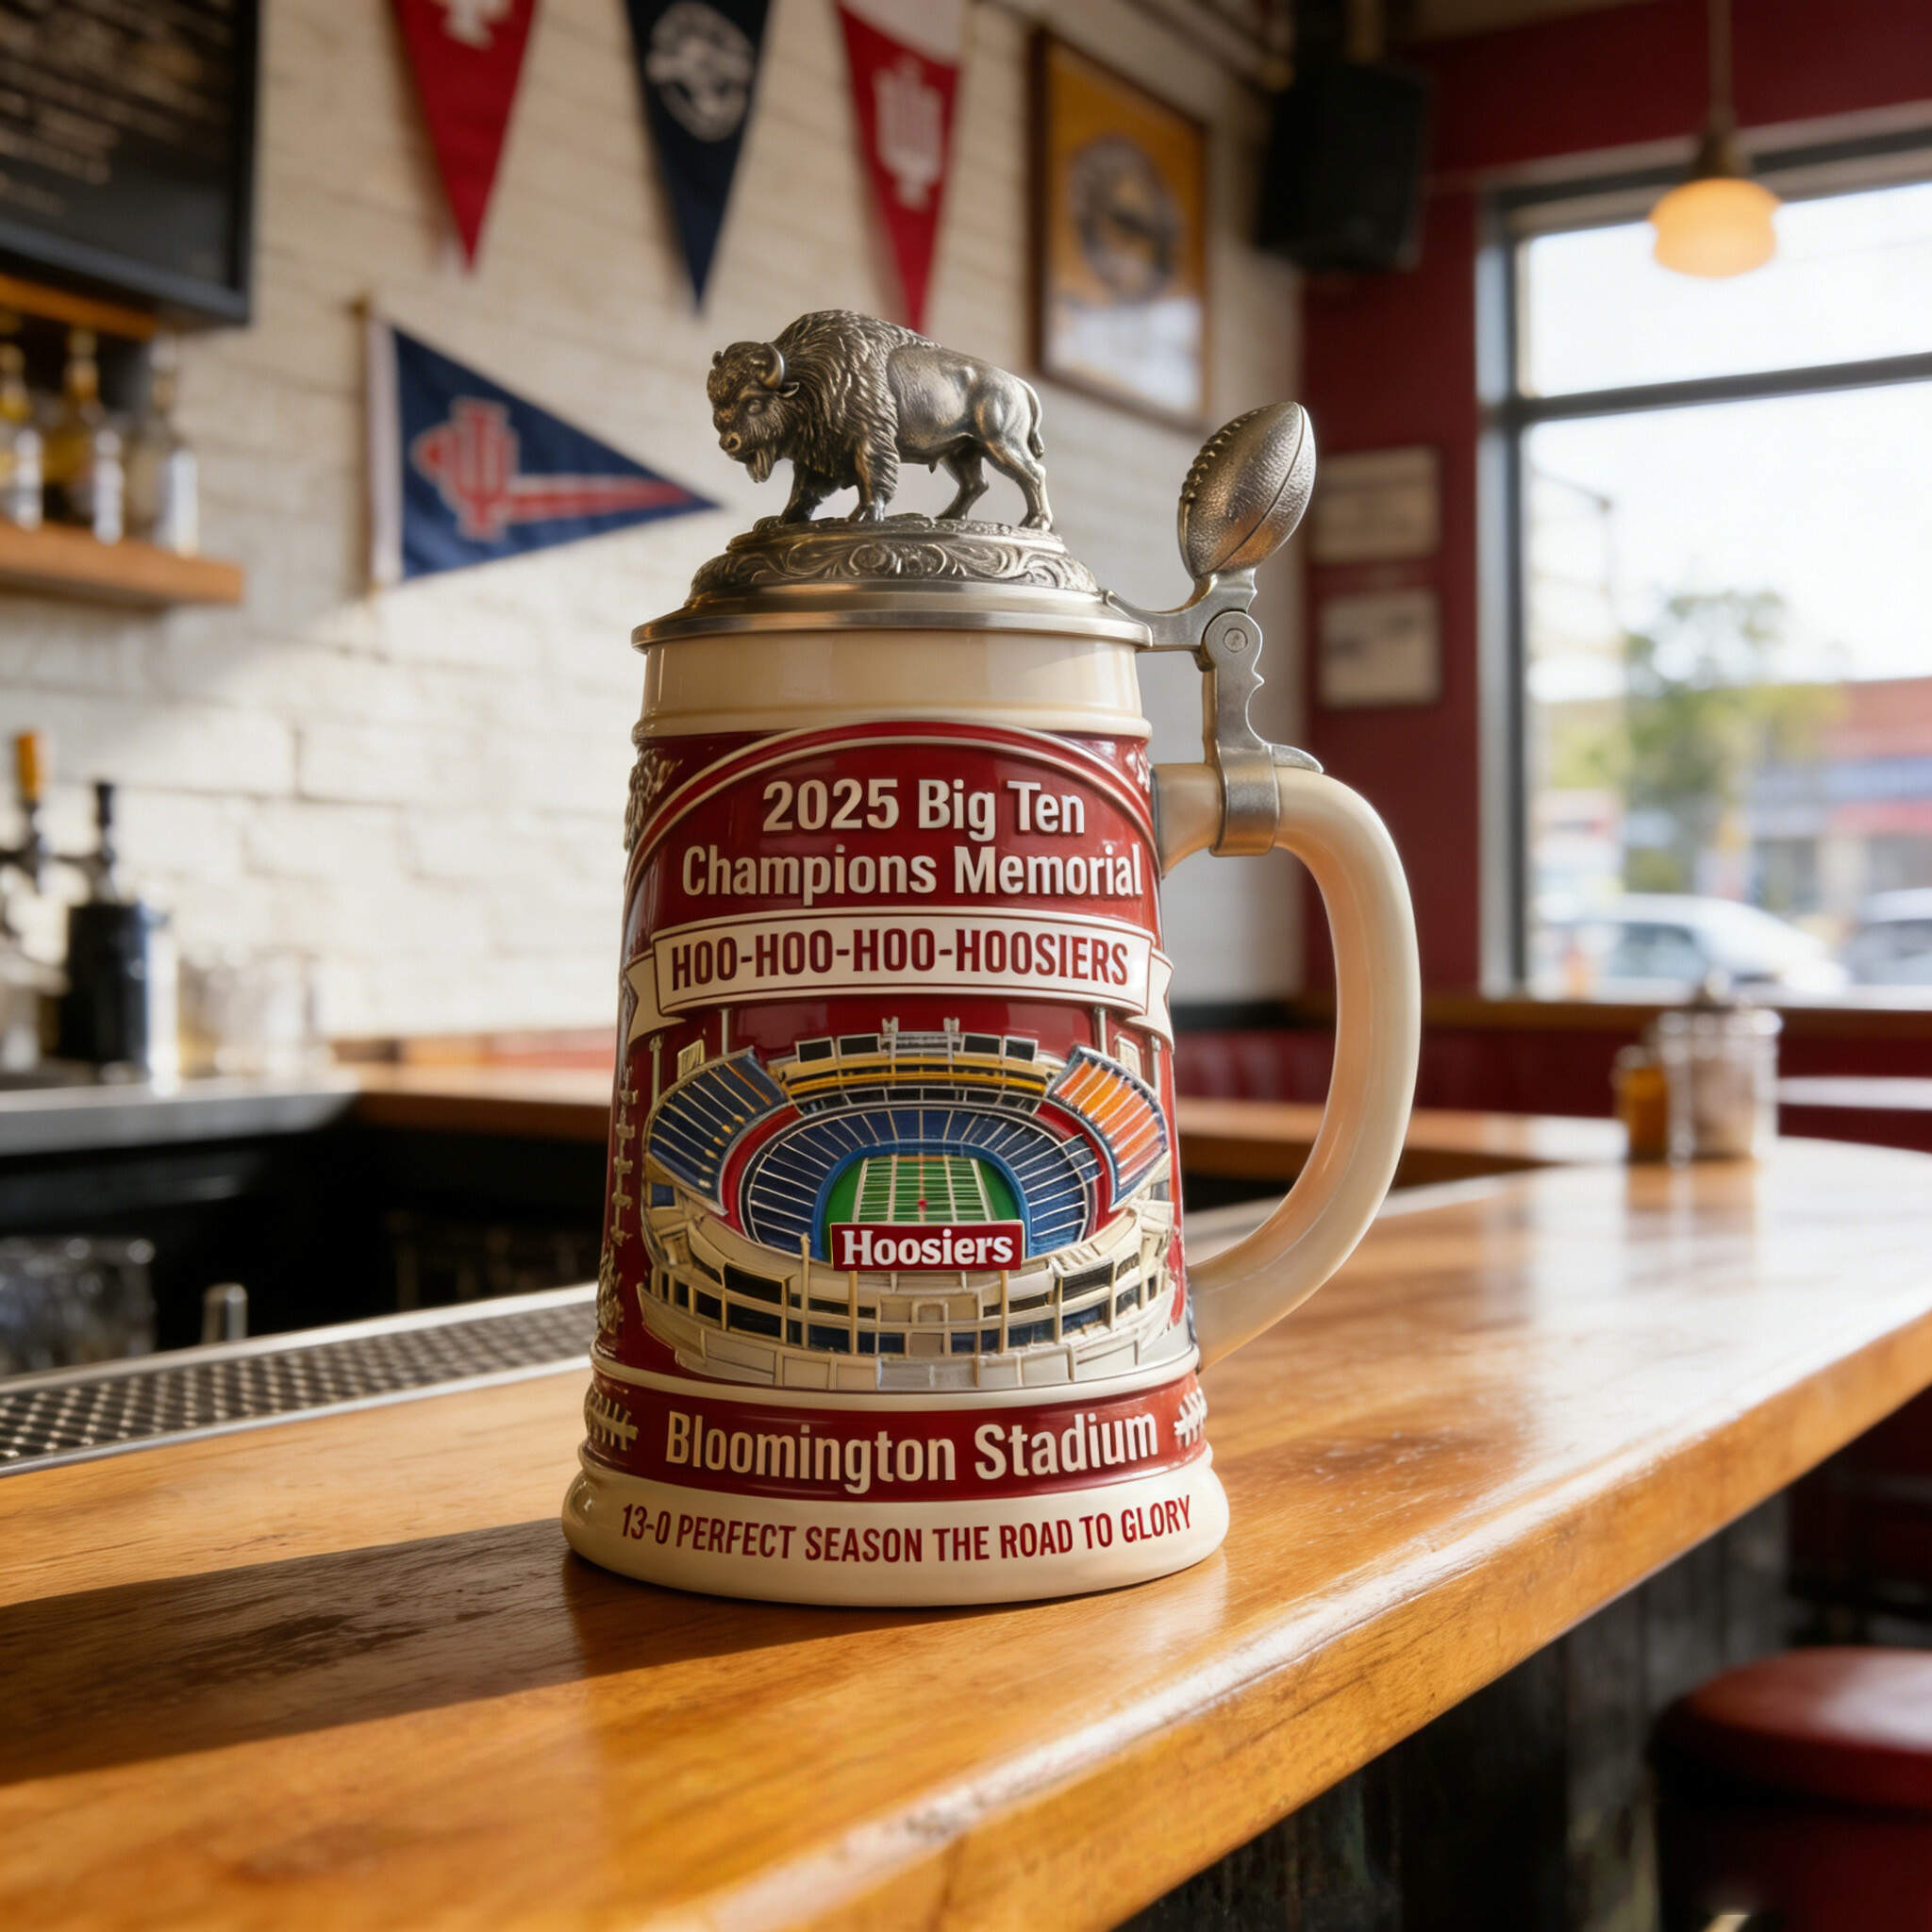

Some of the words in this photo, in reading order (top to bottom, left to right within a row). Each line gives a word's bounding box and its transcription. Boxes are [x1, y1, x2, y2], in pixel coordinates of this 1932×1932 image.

[762, 778, 899, 832] 2025
[918, 778, 996, 841] Big
[1007, 779, 1086, 835] Ten
[681, 844, 937, 906] Champions
[953, 845, 1143, 896] Memorial
[671, 928, 1128, 991] HOO-HOO-HOO-HOOSIERS
[841, 1228, 1013, 1266] Hoosiers
[664, 1410, 957, 1493] Bloomington
[974, 1412, 1158, 1477] Stadium
[621, 1503, 669, 1545] 13-0
[675, 1518, 796, 1559] PERFECT
[805, 1526, 923, 1562] SEASON
[932, 1527, 990, 1561] THE
[1000, 1518, 1073, 1559] ROAD
[1078, 1515, 1114, 1550] TO
[1120, 1494, 1192, 1544] GLORY
